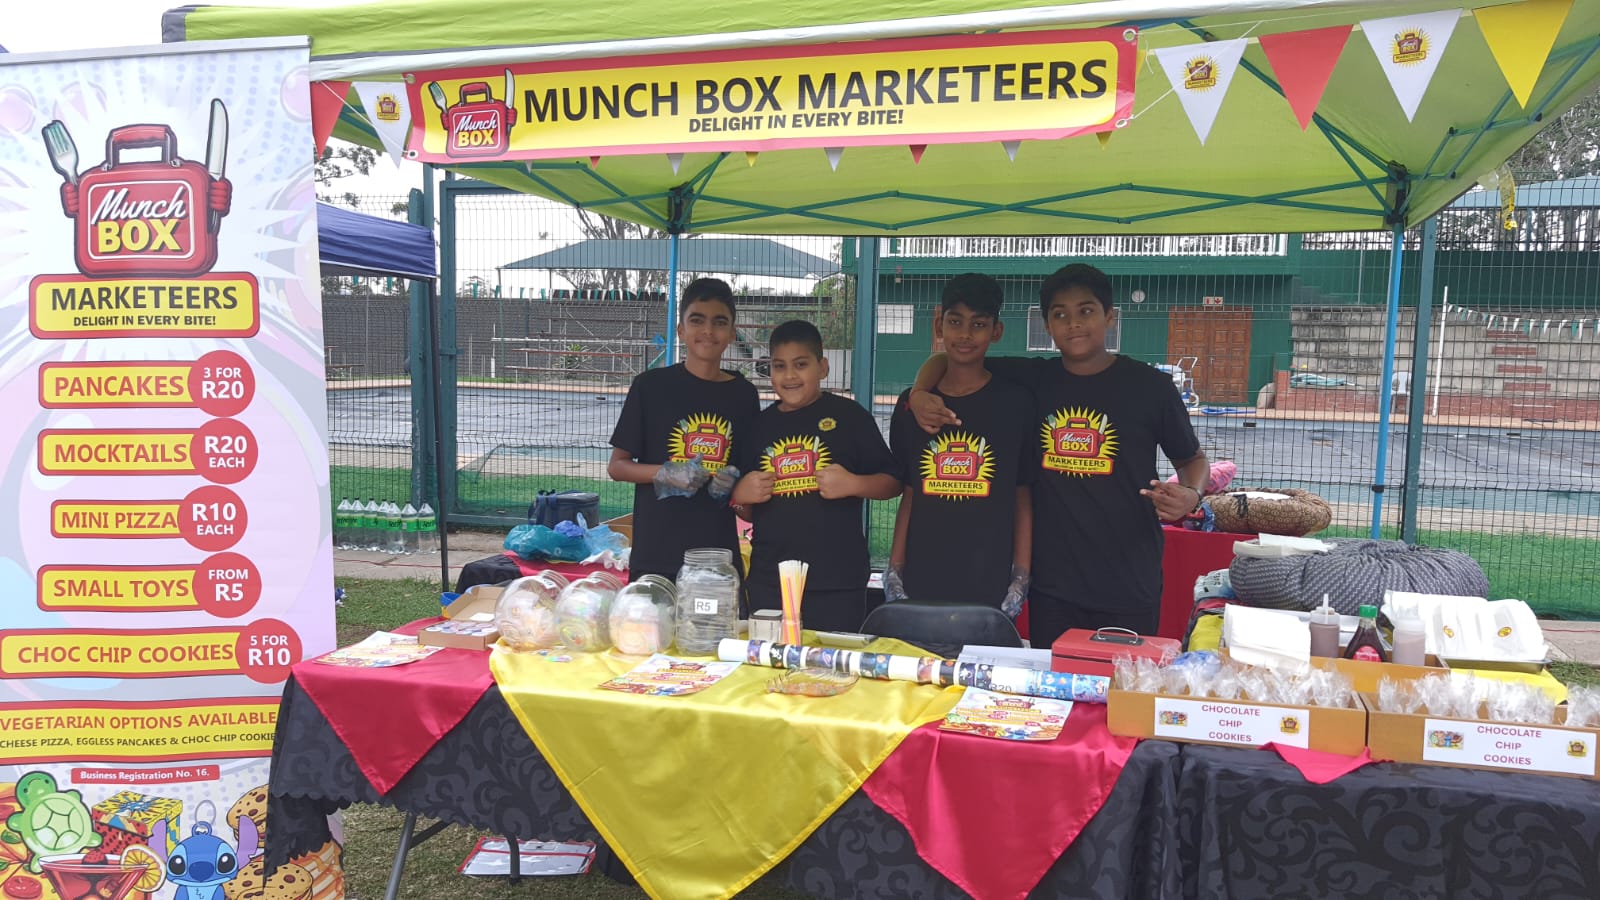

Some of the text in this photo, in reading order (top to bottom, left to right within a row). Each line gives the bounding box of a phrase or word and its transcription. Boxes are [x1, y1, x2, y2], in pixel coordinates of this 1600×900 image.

[524, 59, 1107, 123] MUNCH BOX MARKETEERS
[455, 113, 498, 133] Munch
[688, 109, 904, 133] DELIGHT IN EVERY BITE!
[458, 129, 495, 147] BOX
[91, 185, 186, 224] Munch
[97, 218, 183, 254] BOX
[51, 286, 238, 311] MARKETEERS
[73, 314, 216, 327] DELIGHT IN EVERY BITE!
[203, 367, 242, 378] 3 FOR
[55, 375, 184, 397] PANCAKES
[202, 381, 244, 399] R20
[690, 437, 719, 448] Munch
[1060, 432, 1091, 443] Munch
[204, 435, 248, 454] R20
[692, 445, 716, 455] BOX
[1062, 441, 1089, 451] BOX
[55, 443, 187, 463] MOCKTAILS
[209, 457, 245, 468] EACH
[780, 455, 807, 467] Munch
[941, 456, 971, 466] Munch
[1049, 456, 1106, 467] MARKETEERS
[782, 464, 805, 474] BOX
[943, 465, 968, 474] BOX
[773, 478, 817, 488] ARKETEER
[928, 481, 983, 489] MARKETEERS
[192, 503, 236, 521] R10
[61, 512, 178, 528] MINI PIZZA
[196, 524, 234, 535] EACH
[208, 569, 249, 580] FROM
[54, 579, 189, 598] SMALL TOYS
[215, 583, 244, 602] R5
[696, 601, 711, 611] R5
[250, 635, 288, 646] 5 FOR
[18, 644, 234, 664] CHOC CHIP COOKIES
[248, 648, 291, 666] R10
[1201, 705, 1261, 717] CHOCOLATE
[0, 711, 277, 731] VEGETARIAN OPTIONS AVAILABLE
[1219, 719, 1242, 728] CHIP
[1209, 731, 1252, 742] COOKIES
[1477, 725, 1542, 738] CHOCOLATE
[0, 733, 275, 749] CHEESE PIZZA, EGGLESS PANCAKES & CHOC CHIP COOKIE
[1495, 741, 1522, 750] CHIP
[1484, 754, 1532, 765] COOKIES
[80, 768, 210, 781] Business Registration No. 16.
